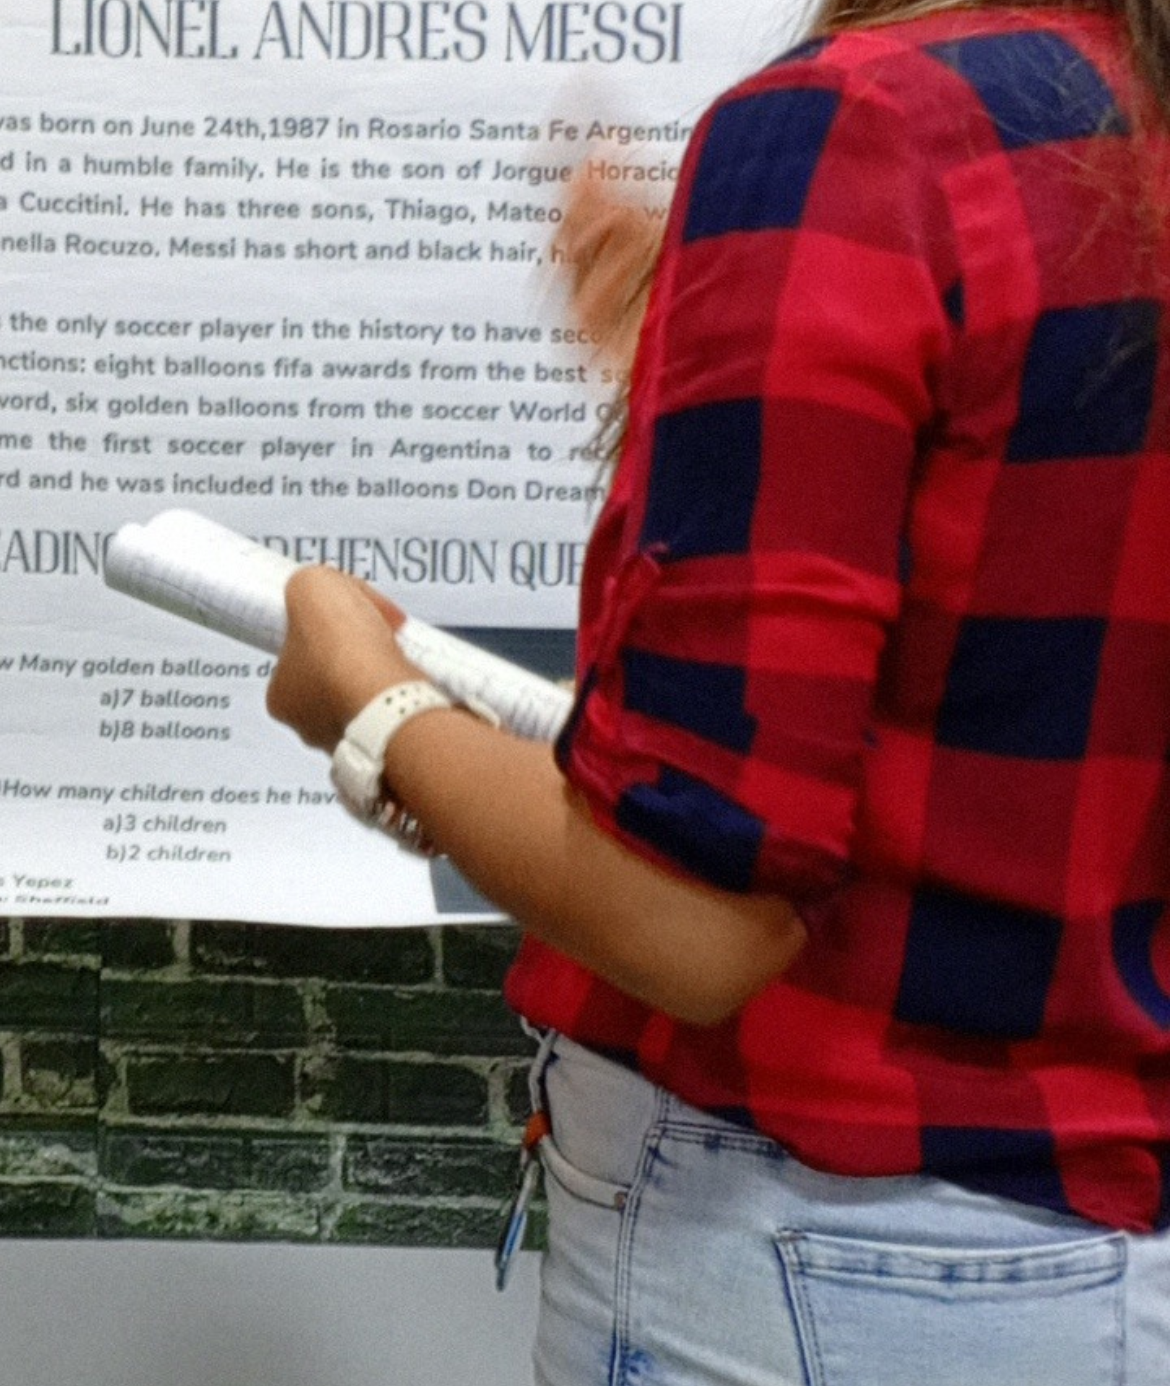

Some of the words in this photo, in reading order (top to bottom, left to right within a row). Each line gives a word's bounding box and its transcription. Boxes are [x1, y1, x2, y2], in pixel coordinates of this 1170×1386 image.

[254, 0, 487, 63] ANDRES
[506, 1, 683, 63] MESSI
[40, 113, 95, 134] born
[103, 119, 132, 135] on
[140, 116, 195, 137] June
[337, 118, 358, 139] in
[368, 118, 461, 140] Rosario
[469, 119, 540, 141] Santa
[549, 120, 578, 141] Fe
[586, 120, 692, 144] Argentin
[26, 151, 47, 172] in
[58, 158, 72, 173] a
[83, 154, 173, 176] humble
[184, 156, 265, 182] family.
[276, 158, 310, 178] He
[321, 158, 340, 179] is
[351, 159, 391, 179] the
[401, 165, 444, 180] son
[456, 159, 482, 180] of
[491, 161, 572, 185] Jorgue
[19, 191, 130, 217] Cuccitini.
[140, 196, 174, 216] He
[184, 197, 226, 218] has
[237, 198, 301, 219] three
[311, 202, 374, 222] sons,
[385, 198, 476, 224] Thiago,
[487, 201, 562, 223] Mateo
[64, 233, 160, 258] Rocuzo.
[169, 236, 236, 258] Messi
[245, 238, 286, 259] has
[294, 239, 357, 260] short
[365, 240, 410, 261] and
[418, 240, 482, 262] black
[490, 241, 543, 266] hair,
[8, 311, 48, 333] the
[56, 314, 108, 338] only
[114, 321, 192, 337] soccer
[199, 319, 275, 343] player
[282, 318, 304, 338] in
[312, 320, 351, 339] the
[359, 319, 444, 345] history
[451, 323, 476, 341] to
[484, 322, 542, 342] have
[94, 354, 156, 378] eight
[164, 355, 266, 378] balloons
[274, 357, 312, 378] fifa
[322, 359, 411, 380] awards
[420, 359, 477, 381] from
[487, 362, 526, 382] the
[534, 362, 587, 383] best
[66, 393, 98, 413] six
[107, 394, 189, 419] golden
[199, 397, 298, 419] balloons
[308, 398, 364, 420] from
[374, 400, 413, 419] the
[421, 405, 500, 422] soccer
[509, 400, 586, 422] World
[48, 430, 87, 451] the
[102, 433, 152, 454] first
[167, 438, 245, 456] soccer
[261, 436, 335, 461] player
[351, 437, 373, 458] in
[389, 439, 511, 464] Argentina
[529, 442, 552, 461] to
[29, 470, 73, 491] and
[81, 471, 109, 492] he
[116, 477, 165, 494] was
[172, 473, 274, 496] included
[281, 475, 302, 496] in
[310, 477, 349, 497] the
[357, 477, 459, 499] balloons
[468, 479, 516, 499] Don
[20, 654, 77, 677] Many
[82, 657, 154, 678] golden
[161, 658, 250, 678] balloons
[140, 689, 231, 710] balloons
[140, 721, 231, 741] balloons
[57, 786, 113, 804] many
[120, 784, 204, 804] children
[210, 786, 260, 804] does
[266, 788, 291, 805] he
[298, 788, 337, 805] hav
[143, 815, 227, 834] children
[147, 845, 231, 863] children
[13, 874, 74, 890] Yepez
